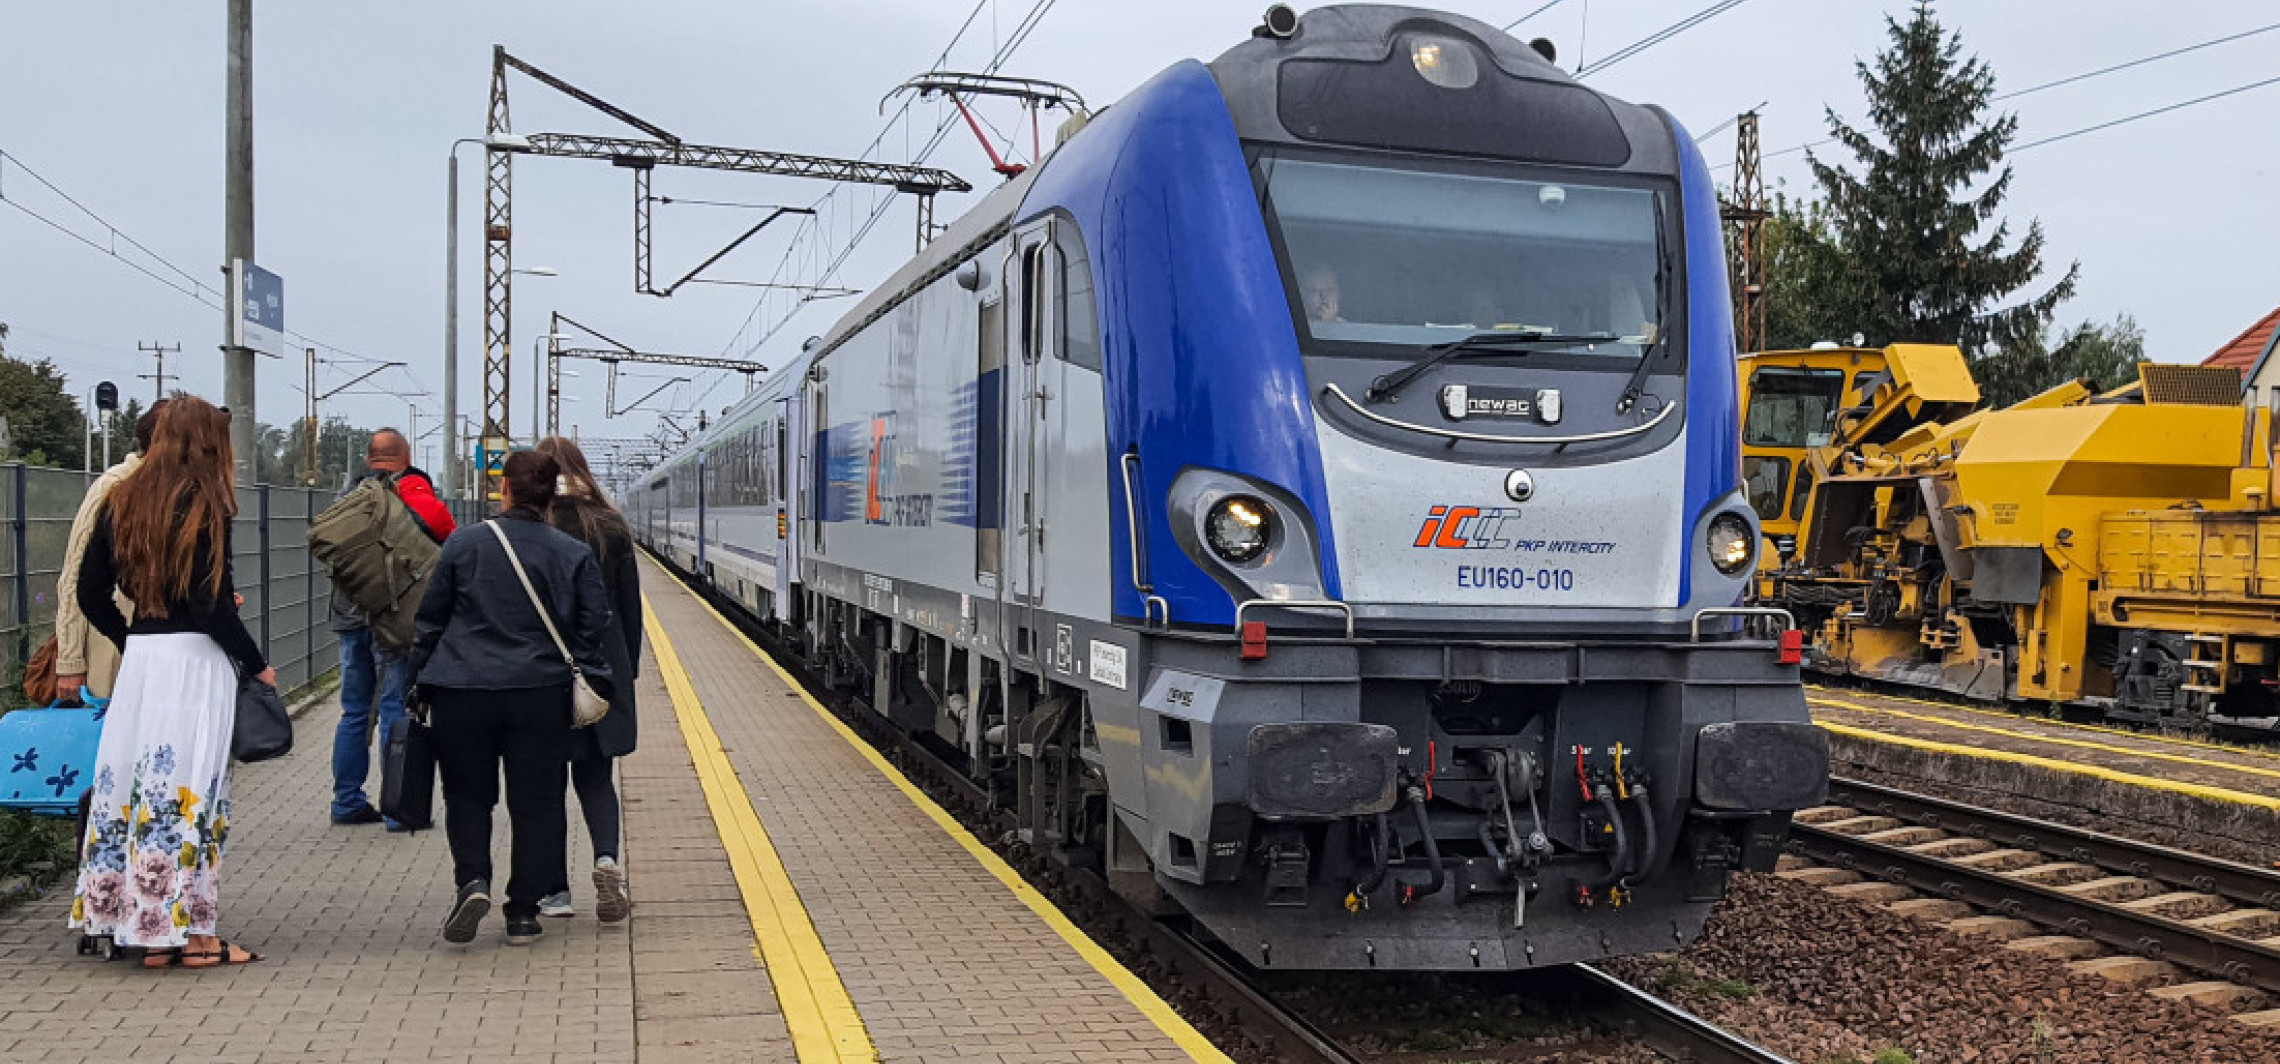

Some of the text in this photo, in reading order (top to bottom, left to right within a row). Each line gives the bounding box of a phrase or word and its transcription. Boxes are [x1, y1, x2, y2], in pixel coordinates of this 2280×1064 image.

[1515, 539, 1545, 551] PKP
[1548, 540, 1617, 554] INTERCITY
[1457, 565, 1574, 591] EU160-010
